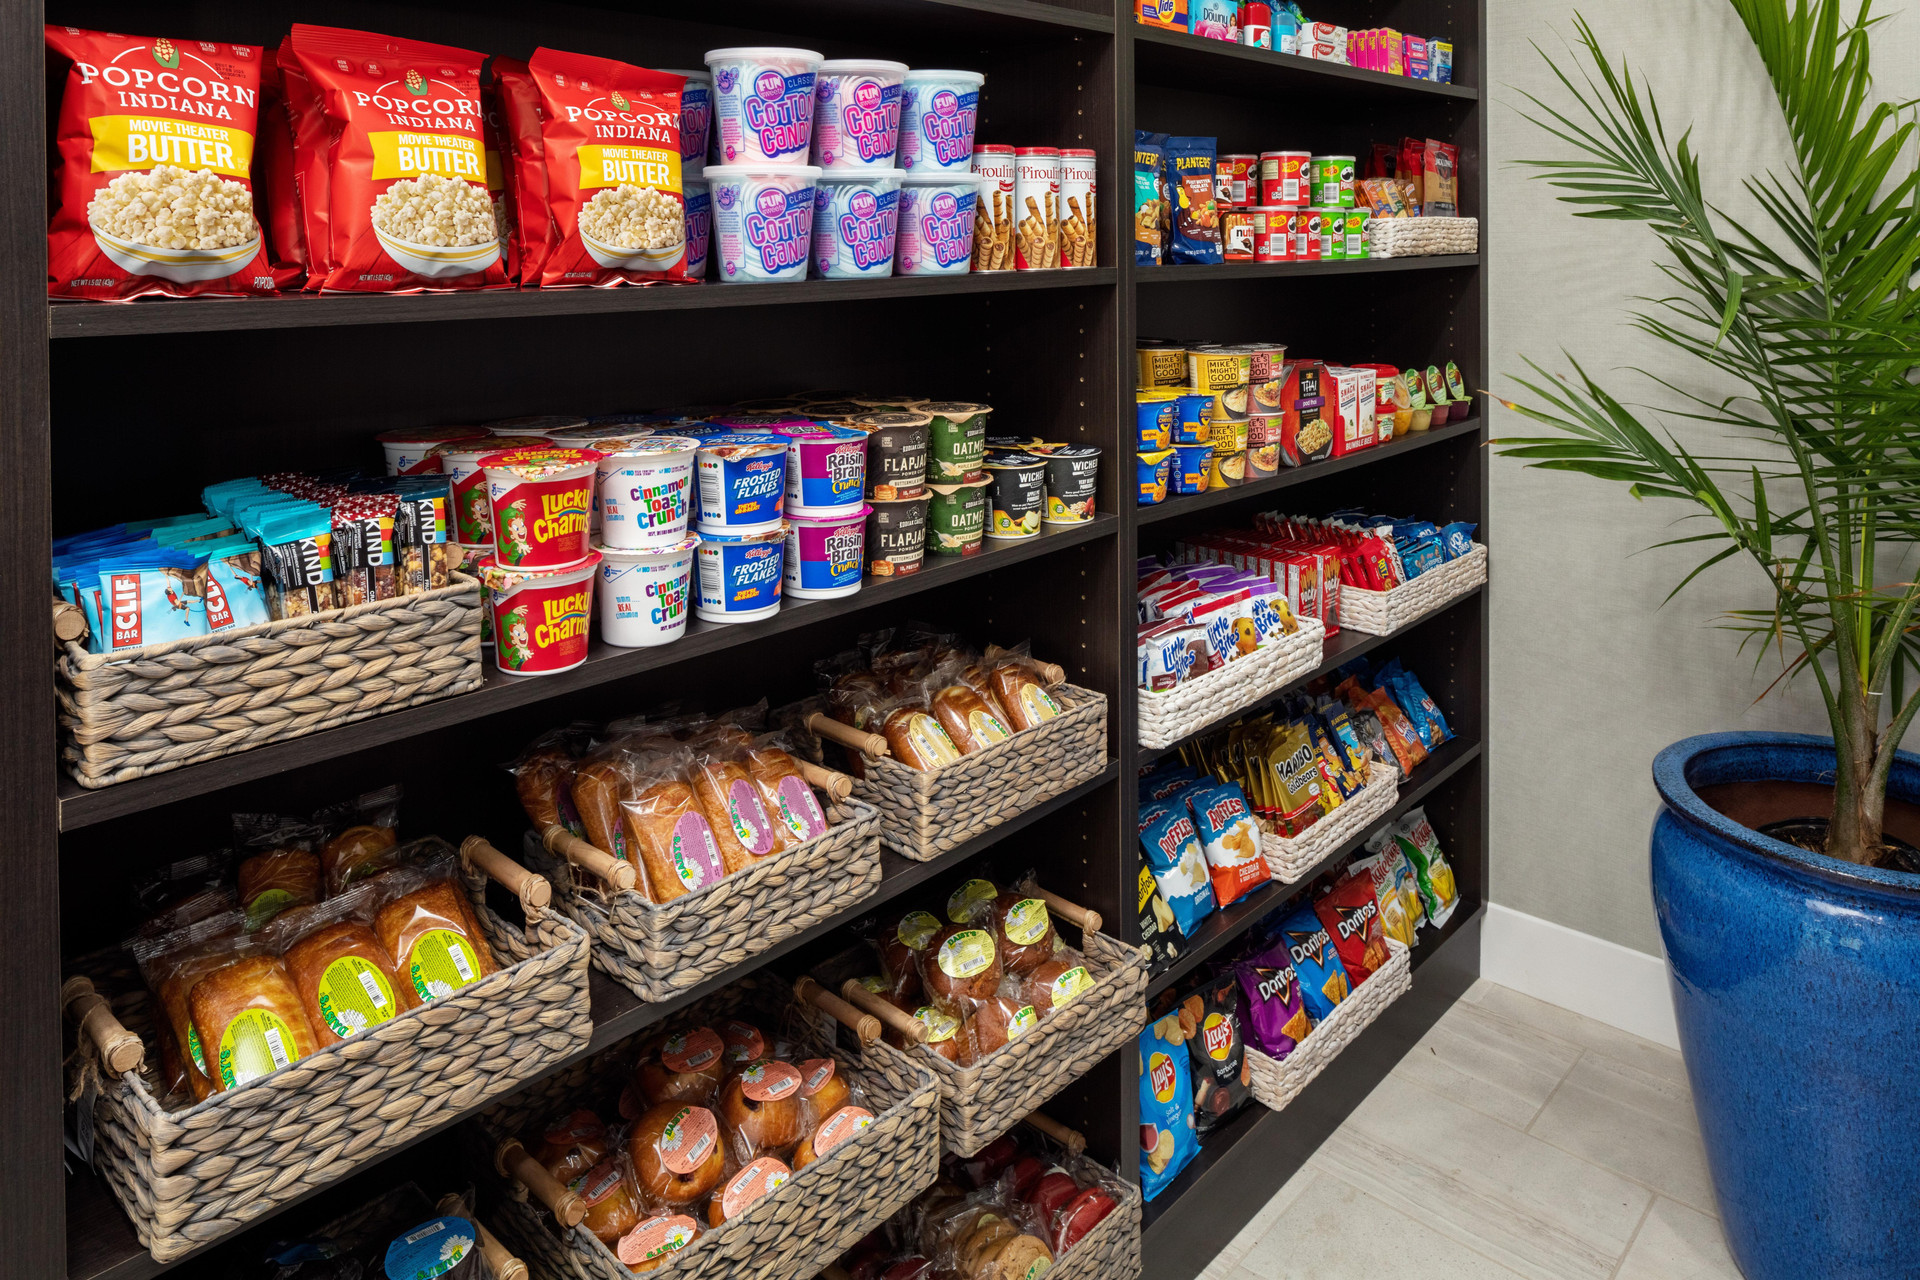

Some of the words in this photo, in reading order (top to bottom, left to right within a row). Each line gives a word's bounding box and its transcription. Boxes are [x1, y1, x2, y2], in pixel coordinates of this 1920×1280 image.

[1204, 8, 1228, 29] Downy
[77, 62, 255, 108] POPCORN
[757, 76, 783, 92] FUN
[858, 87, 878, 100] FUN
[118, 91, 232, 120] INDIANA
[935, 95, 956, 109] FUN
[129, 119, 172, 134] MOVIE
[174, 123, 229, 142] THEATER
[386, 113, 476, 132] INDIANA
[398, 134, 432, 146] MOVIE
[434, 136, 475, 151] THEATER
[595, 124, 672, 144] INDIANA
[127, 134, 235, 169] BUTTER
[602, 148, 629, 159] MOVIE
[631, 149, 668, 162] THEATER
[398, 147, 480, 176] BUTTER
[971, 164, 1014, 178] Piroulin
[1176, 157, 1211, 171] PLANTERS
[603, 159, 670, 185] BUTTER
[1018, 166, 1060, 180] Pirouli
[1060, 167, 1096, 180] Piroul
[760, 194, 783, 209] FUN
[852, 197, 874, 210] FUN
[934, 195, 956, 209] FUN
[1154, 356, 1180, 364] MIKE'S
[1209, 358, 1237, 368] MIKE'S
[1156, 369, 1180, 377] GOOD
[1211, 373, 1237, 382] GOOD
[1301, 380, 1317, 392] THAI
[1341, 384, 1355, 397] SNACK
[1361, 380, 1374, 393] SNACK
[835, 443, 863, 454] Kellogg's
[953, 439, 985, 455] OATME
[1216, 440, 1233, 448] OOD
[1346, 439, 1363, 450] BUMBLE
[1364, 437, 1373, 445] BEE
[746, 461, 774, 472] Kellogg's
[827, 452, 864, 471] Raisin
[884, 453, 926, 472] FLAPJAC
[733, 468, 781, 490] FROSTED
[832, 466, 861, 483] Bran
[1019, 469, 1044, 483] WICKE
[630, 476, 688, 501] Cinnamon
[736, 481, 778, 500] FLAKES
[832, 478, 861, 494] Crunch
[541, 488, 590, 521] Lucky
[644, 490, 682, 513] Toast
[418, 499, 436, 544] KIND
[637, 499, 687, 529] Crunch
[951, 509, 984, 527] OATME
[533, 511, 590, 544] Charms
[833, 524, 861, 537] Kellogg's
[364, 518, 383, 567] KIND
[825, 534, 862, 554] Raisin
[881, 528, 925, 547] FLAPJAC
[299, 537, 324, 585] KIND
[745, 548, 773, 559] Kellogg's
[830, 548, 859, 564] Bran
[732, 553, 780, 577] FROSTED
[830, 561, 859, 577] Crunch
[1377, 558, 1389, 578] RITZ
[645, 570, 690, 597] Cinnamo
[735, 567, 777, 587] FLAKES
[115, 579, 138, 630] CLIF
[658, 582, 688, 608] Toast
[211, 611, 229, 622] BAR
[543, 592, 590, 626] Lucky
[617, 603, 631, 612] REAL
[651, 597, 687, 624] Crunc
[1252, 598, 1268, 616] ttle
[535, 613, 590, 649] Charms
[1255, 610, 1280, 635] Bite
[116, 629, 138, 640] BAR
[1207, 616, 1229, 650] Little
[1218, 629, 1240, 659] Bites
[1163, 637, 1185, 672] Little
[1175, 650, 1195, 683] Bites
[1275, 743, 1313, 782] HARIBO
[1287, 766, 1318, 795] Goldbears
[730, 798, 748, 839] DAISY'S
[779, 795, 800, 831] DAISY'S
[1206, 798, 1246, 832] RUFFLES
[1158, 817, 1194, 863] RUFFLES
[673, 835, 691, 879] DAISY'S
[1239, 862, 1260, 877] CHEDDAR
[1012, 900, 1034, 915] DAISY'S
[1337, 900, 1376, 939] Doritos
[947, 931, 977, 946] DAISY'S
[1290, 928, 1330, 963] Doritos
[1058, 967, 1084, 985] DAISY'S
[1259, 963, 1297, 1001] Doritos
[319, 992, 349, 1038] DAISY'S
[1015, 1006, 1035, 1023] DAISY
[1205, 1019, 1232, 1052] Lay's
[1150, 1059, 1175, 1094] Lay's
[1216, 1059, 1238, 1078] Barbecue
[1166, 1106, 1175, 1118] Salt
